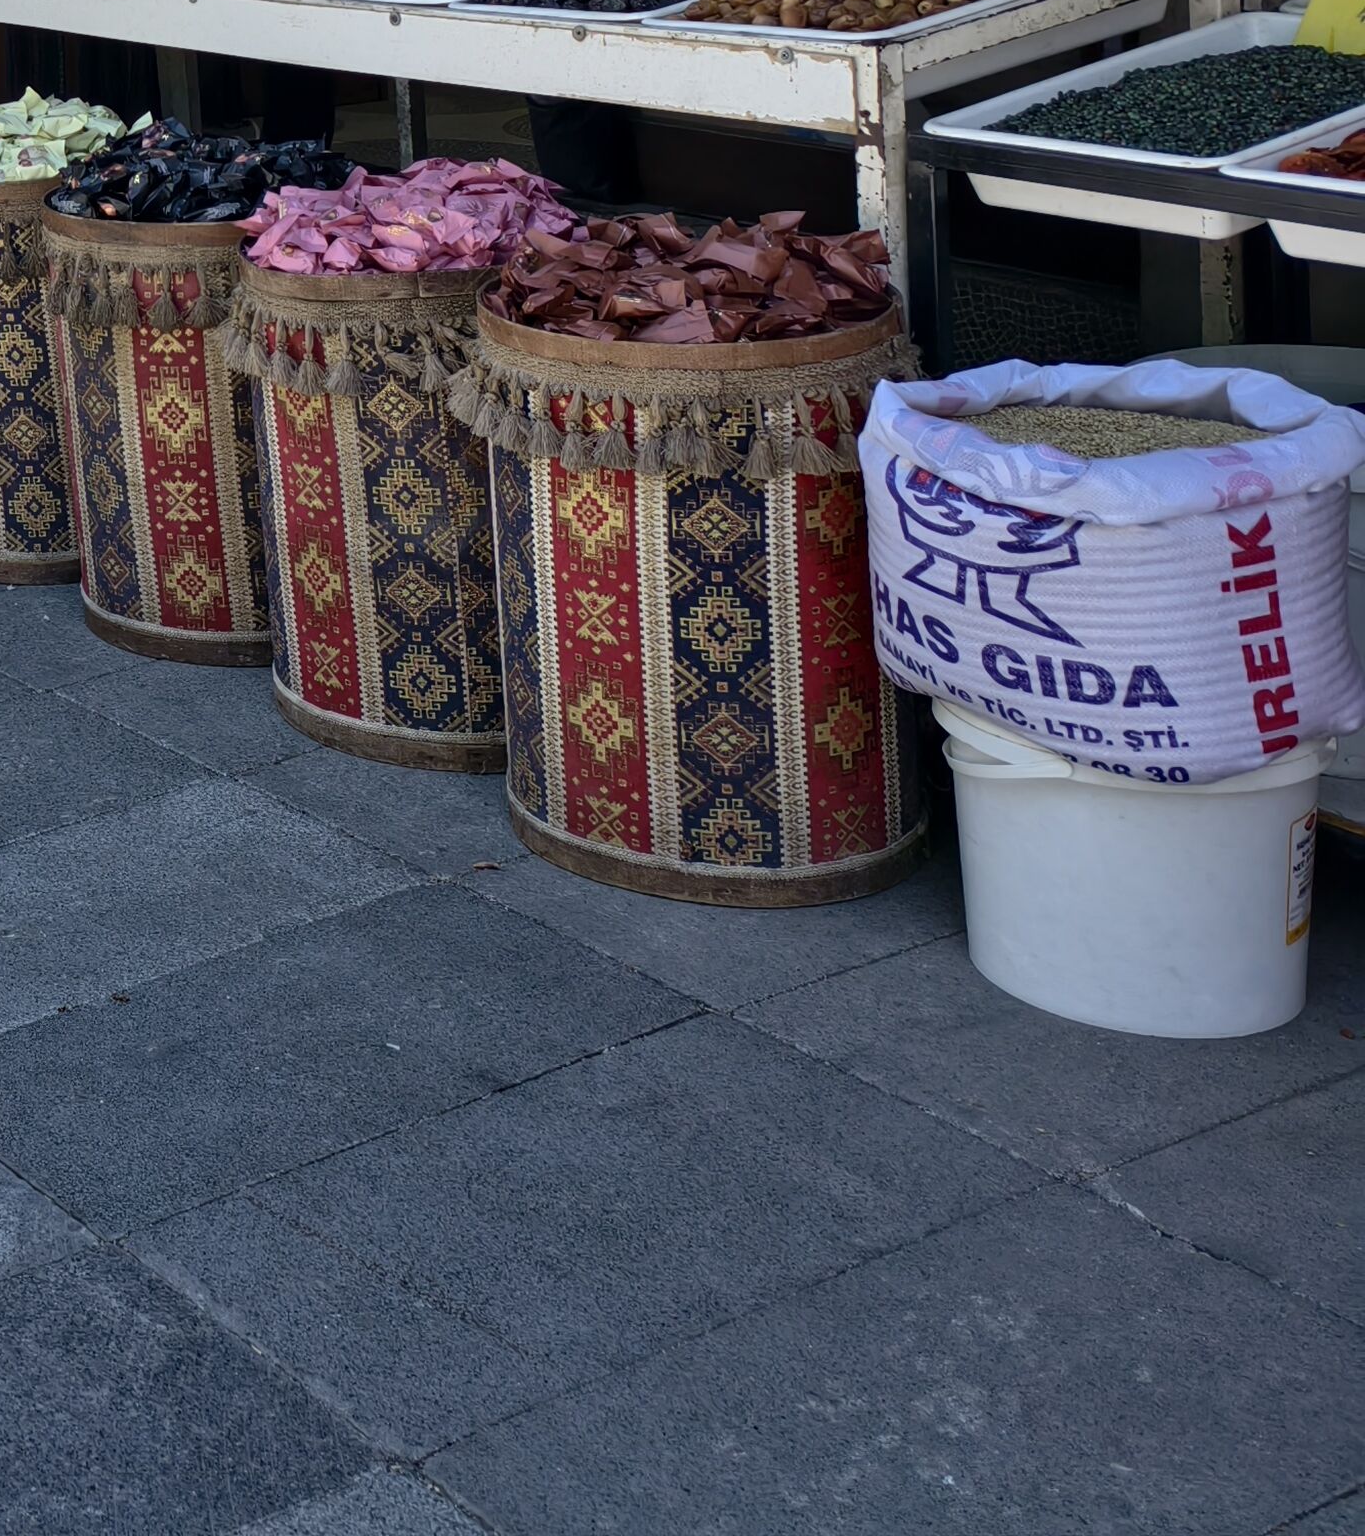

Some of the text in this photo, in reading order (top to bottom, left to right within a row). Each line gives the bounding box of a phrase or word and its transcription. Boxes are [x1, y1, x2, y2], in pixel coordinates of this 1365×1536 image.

[872, 569, 961, 664] HAS
[878, 629, 1190, 752] SANAYİ ve TİC. LTD. ŞTİ.
[981, 643, 1180, 708] GIDA
[1145, 766, 1190, 784] 30
